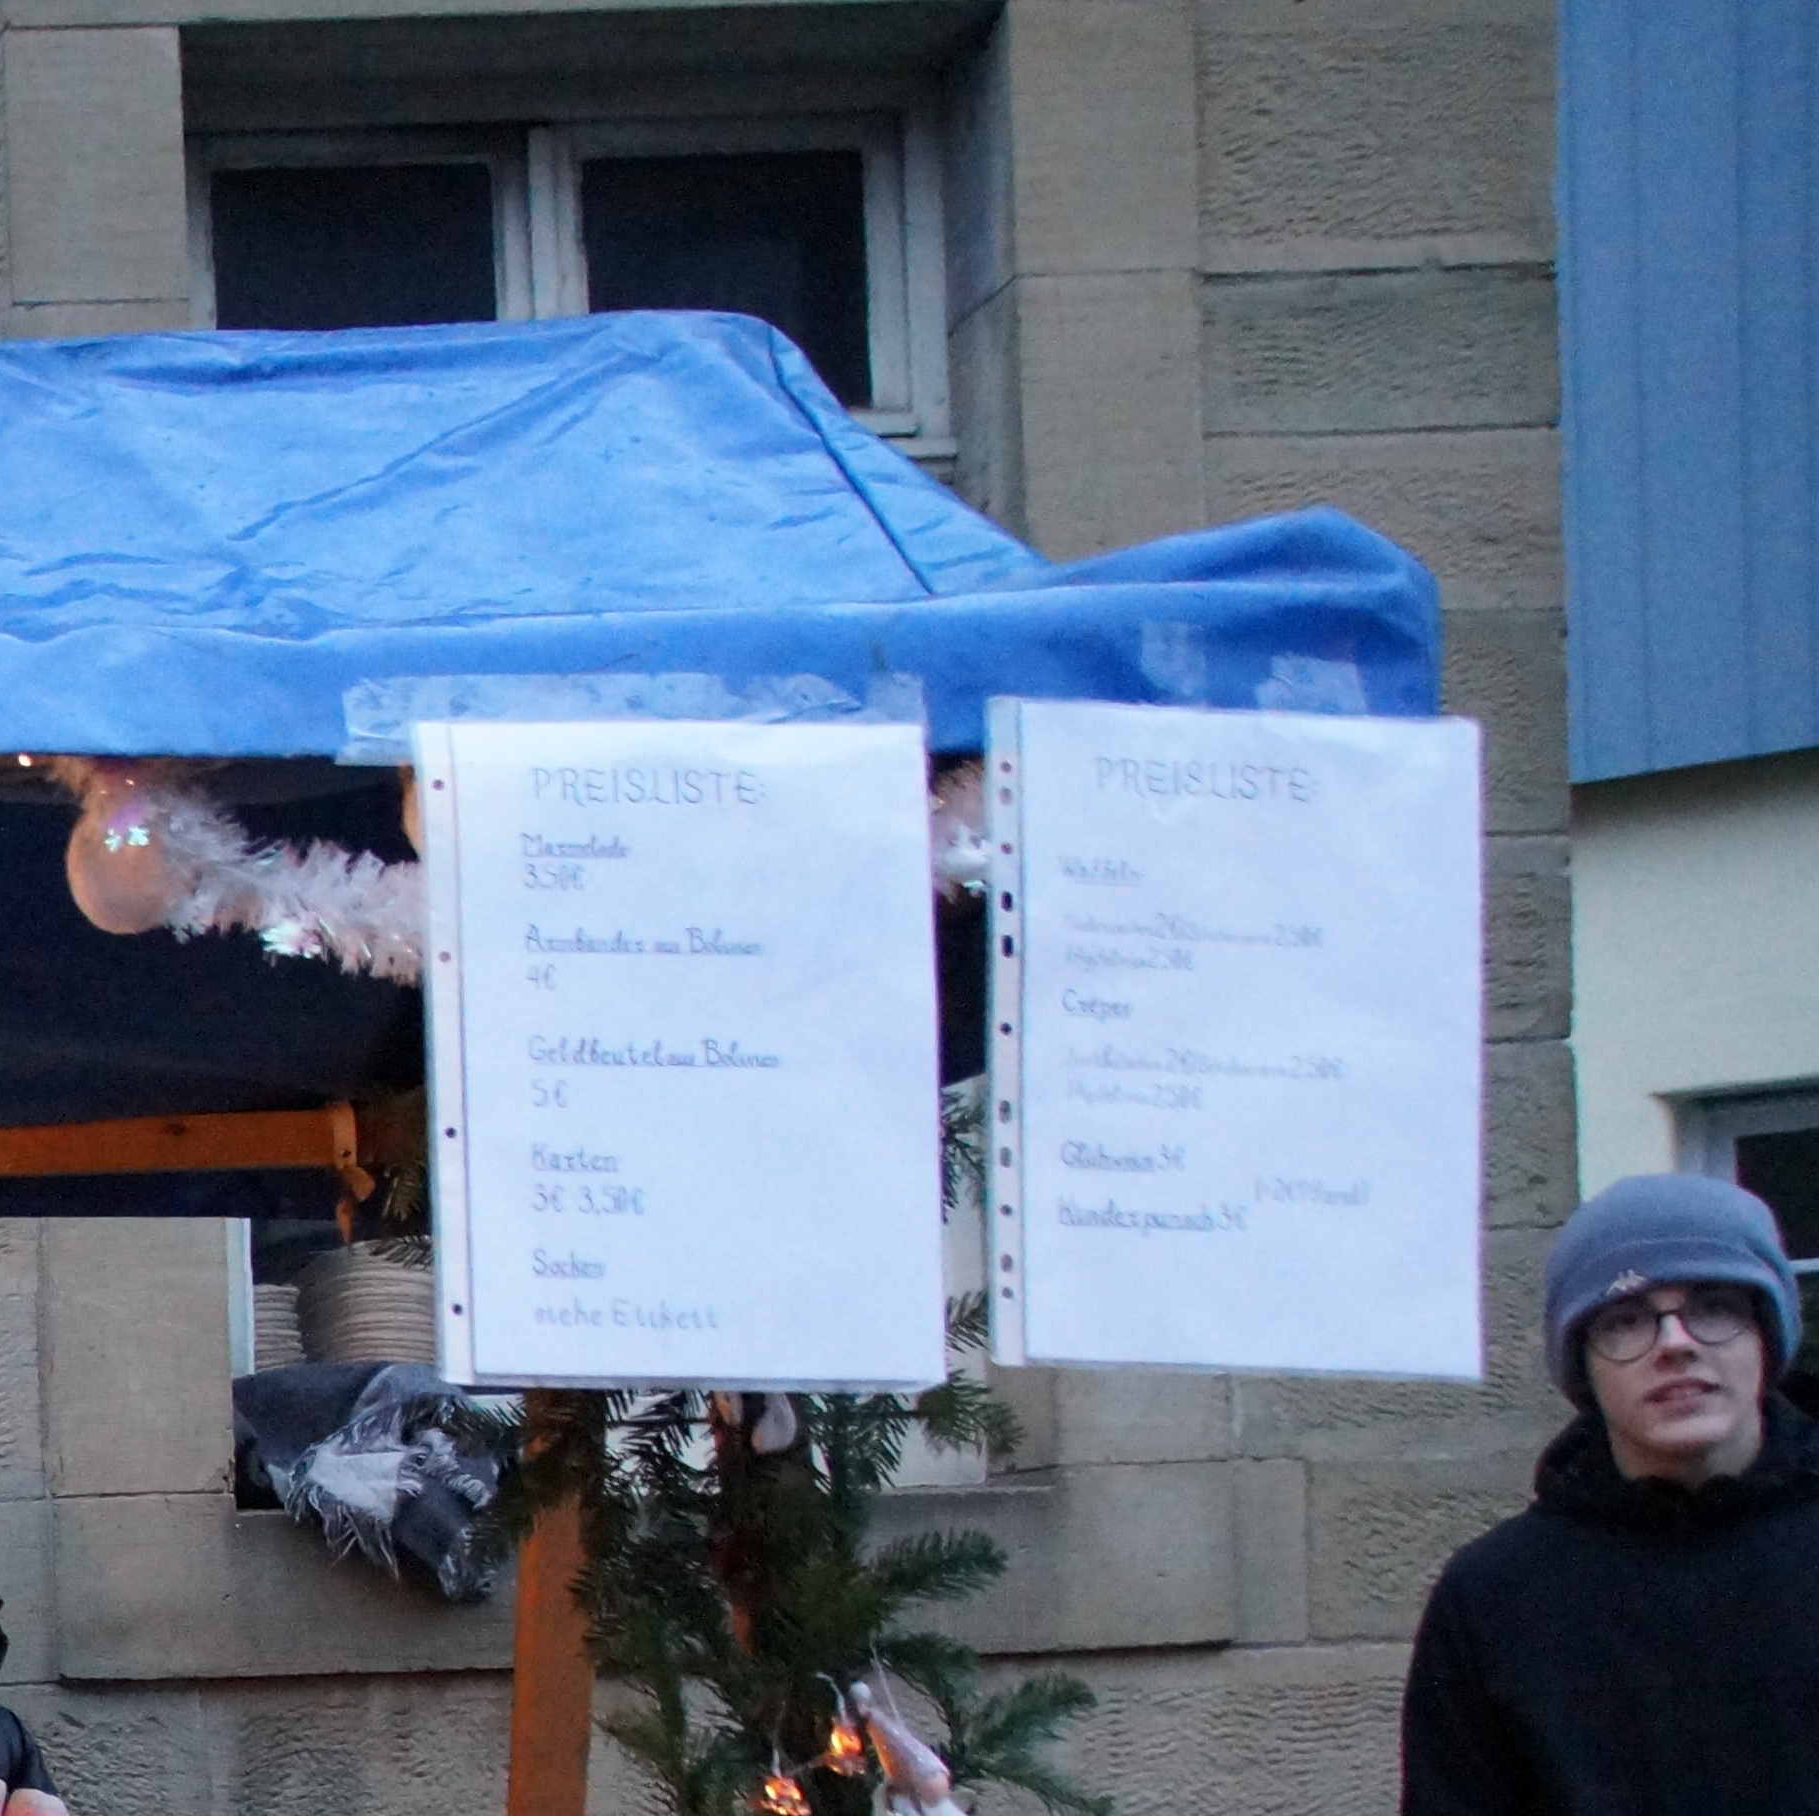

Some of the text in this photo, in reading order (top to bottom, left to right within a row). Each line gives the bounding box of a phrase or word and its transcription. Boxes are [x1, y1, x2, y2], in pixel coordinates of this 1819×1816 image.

[528, 1035, 664, 1068] Geldbeutel
[531, 1140, 620, 1173] Karten
[533, 1298, 603, 1328] siehe
